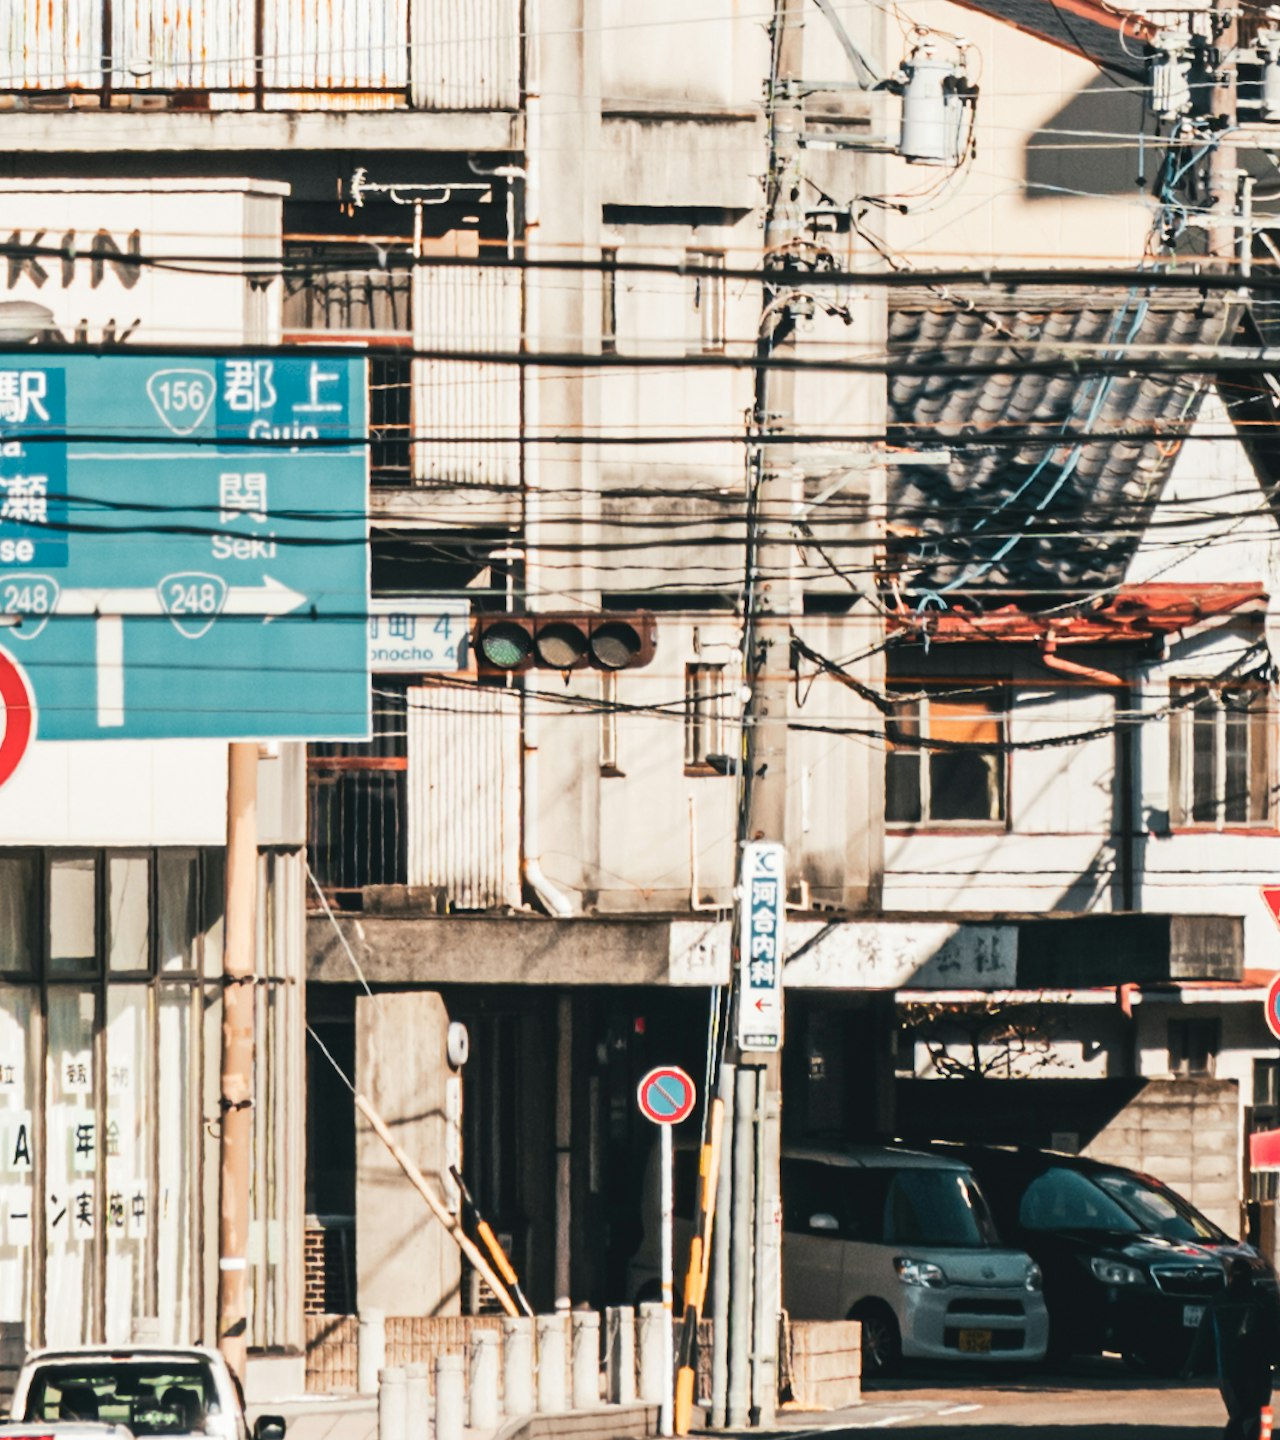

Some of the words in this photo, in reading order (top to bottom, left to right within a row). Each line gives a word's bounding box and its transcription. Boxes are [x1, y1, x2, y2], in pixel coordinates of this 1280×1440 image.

[159, 381, 205, 411] 156
[223, 359, 343, 413] 郡上
[220, 473, 267, 524] 関
[211, 532, 277, 560] Seki
[4, 584, 48, 614] 248
[170, 584, 216, 614] 248
[433, 612, 453, 641] 4
[371, 643, 434, 662] onocho
[750, 881, 777, 987] 河合内科
